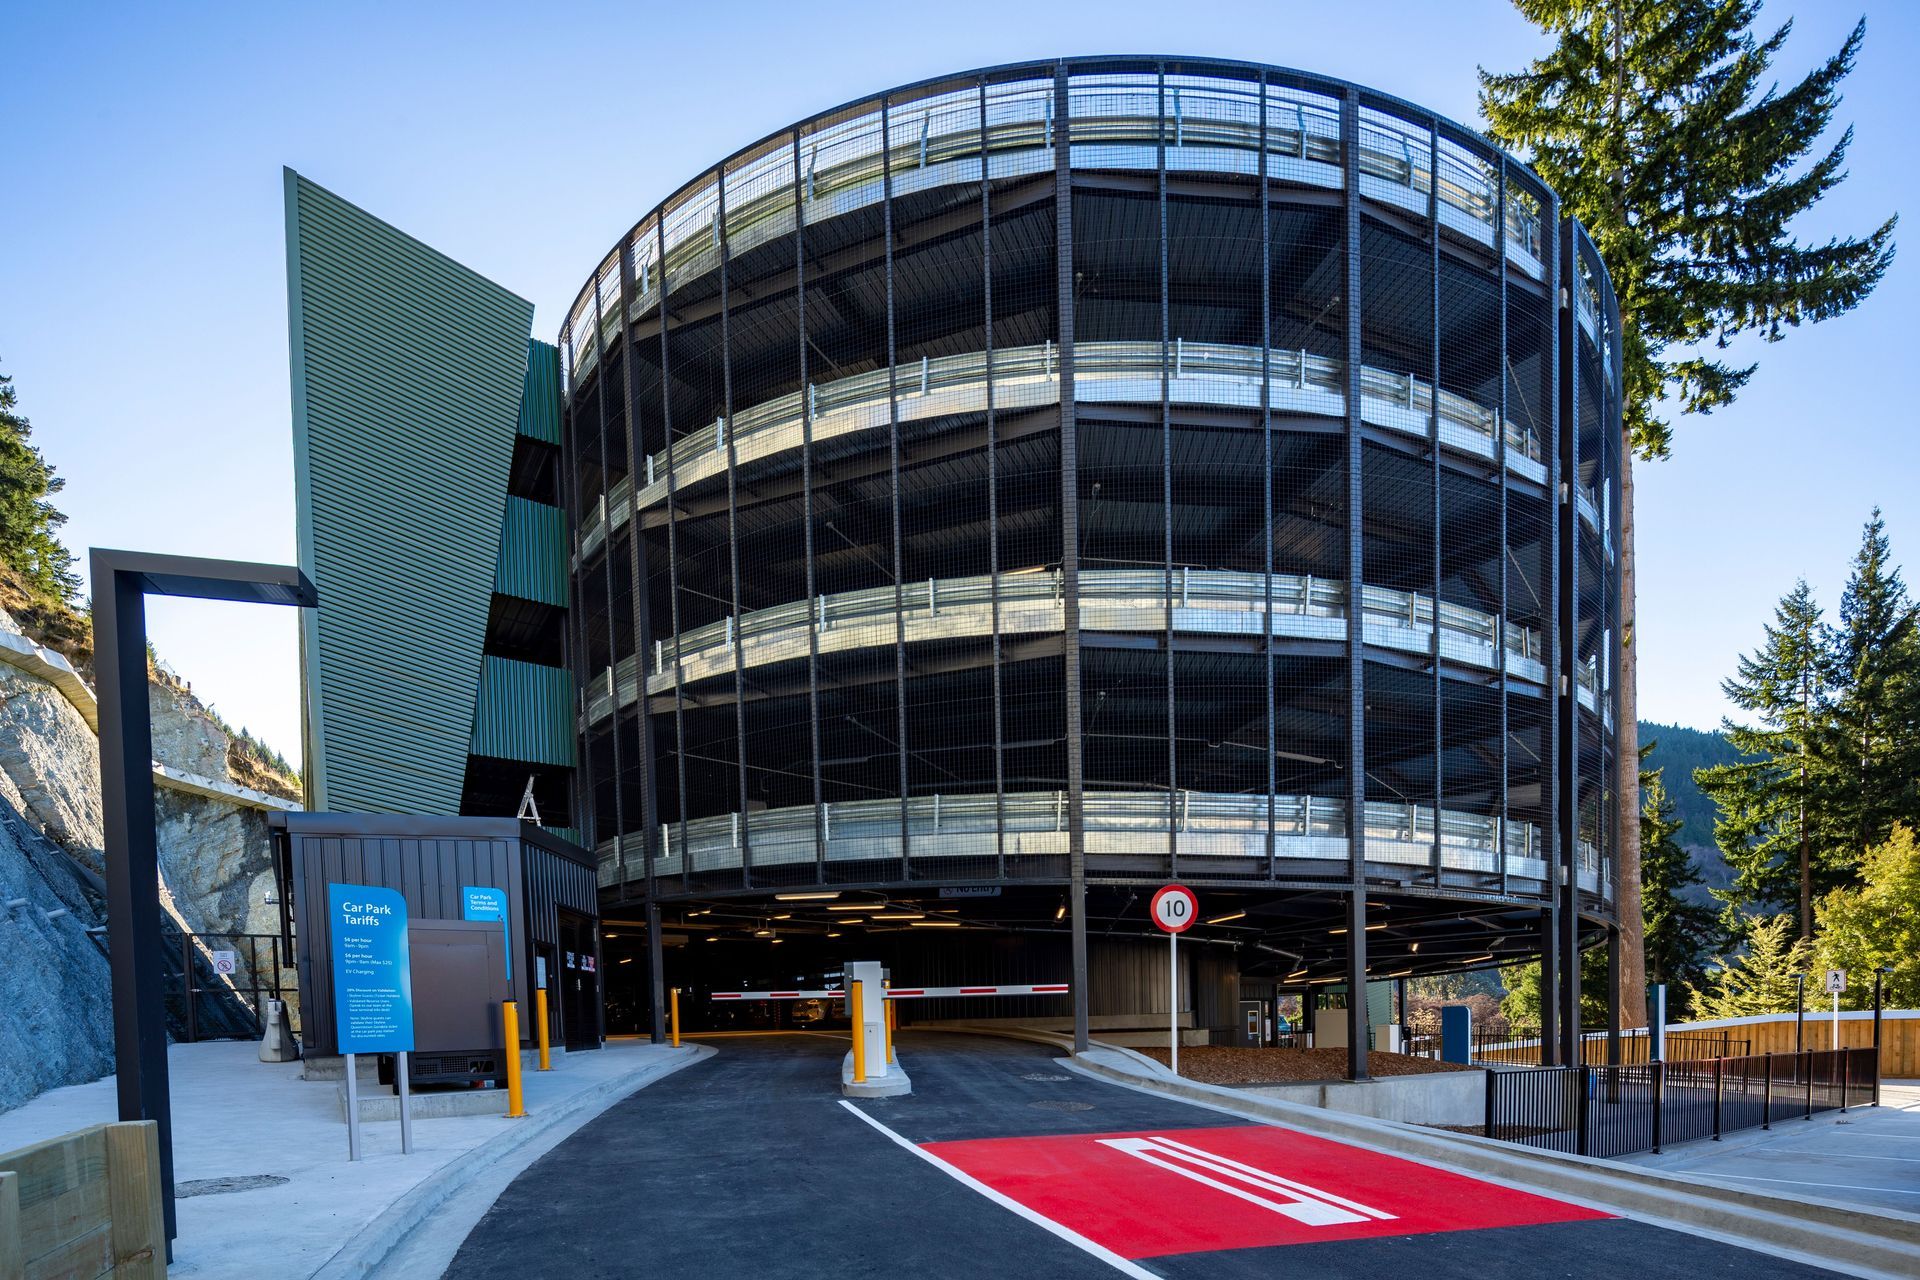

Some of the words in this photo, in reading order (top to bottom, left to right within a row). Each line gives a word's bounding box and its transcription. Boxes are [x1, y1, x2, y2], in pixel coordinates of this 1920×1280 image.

[342, 902, 363, 912] Car
[366, 903, 391, 915] Park
[1166, 900, 1185, 917] 10
[343, 914, 379, 926] Tariffs
